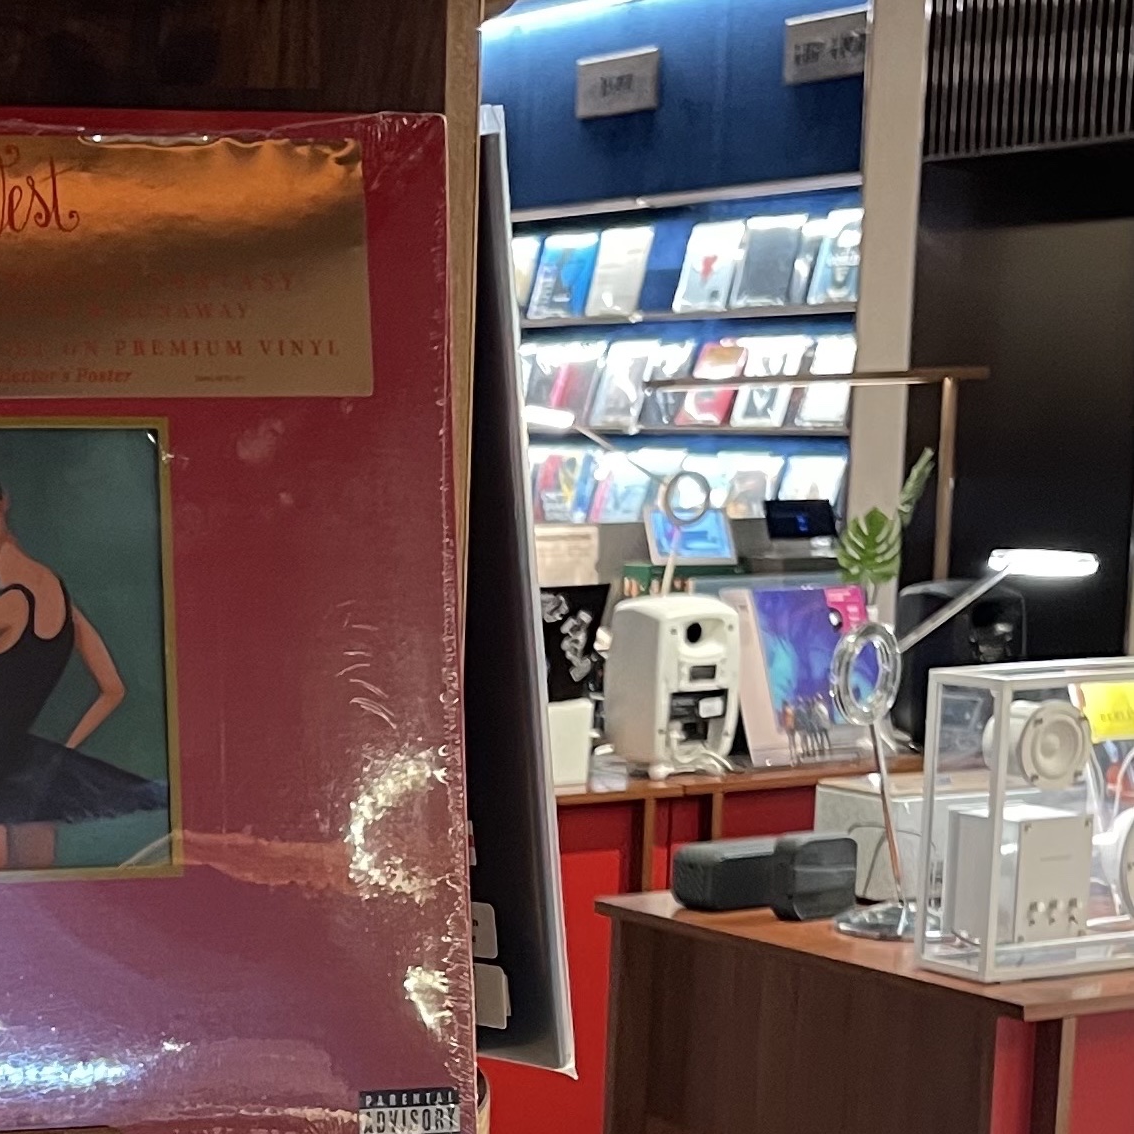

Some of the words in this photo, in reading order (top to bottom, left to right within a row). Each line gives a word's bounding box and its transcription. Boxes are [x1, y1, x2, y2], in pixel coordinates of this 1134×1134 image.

[115, 339, 243, 356] PREMIUM
[259, 338, 339, 356] VINYL
[75, 367, 133, 383] Poster
[365, 1090, 452, 1107] PARENTAL
[363, 1107, 456, 1134] ADVISORY
